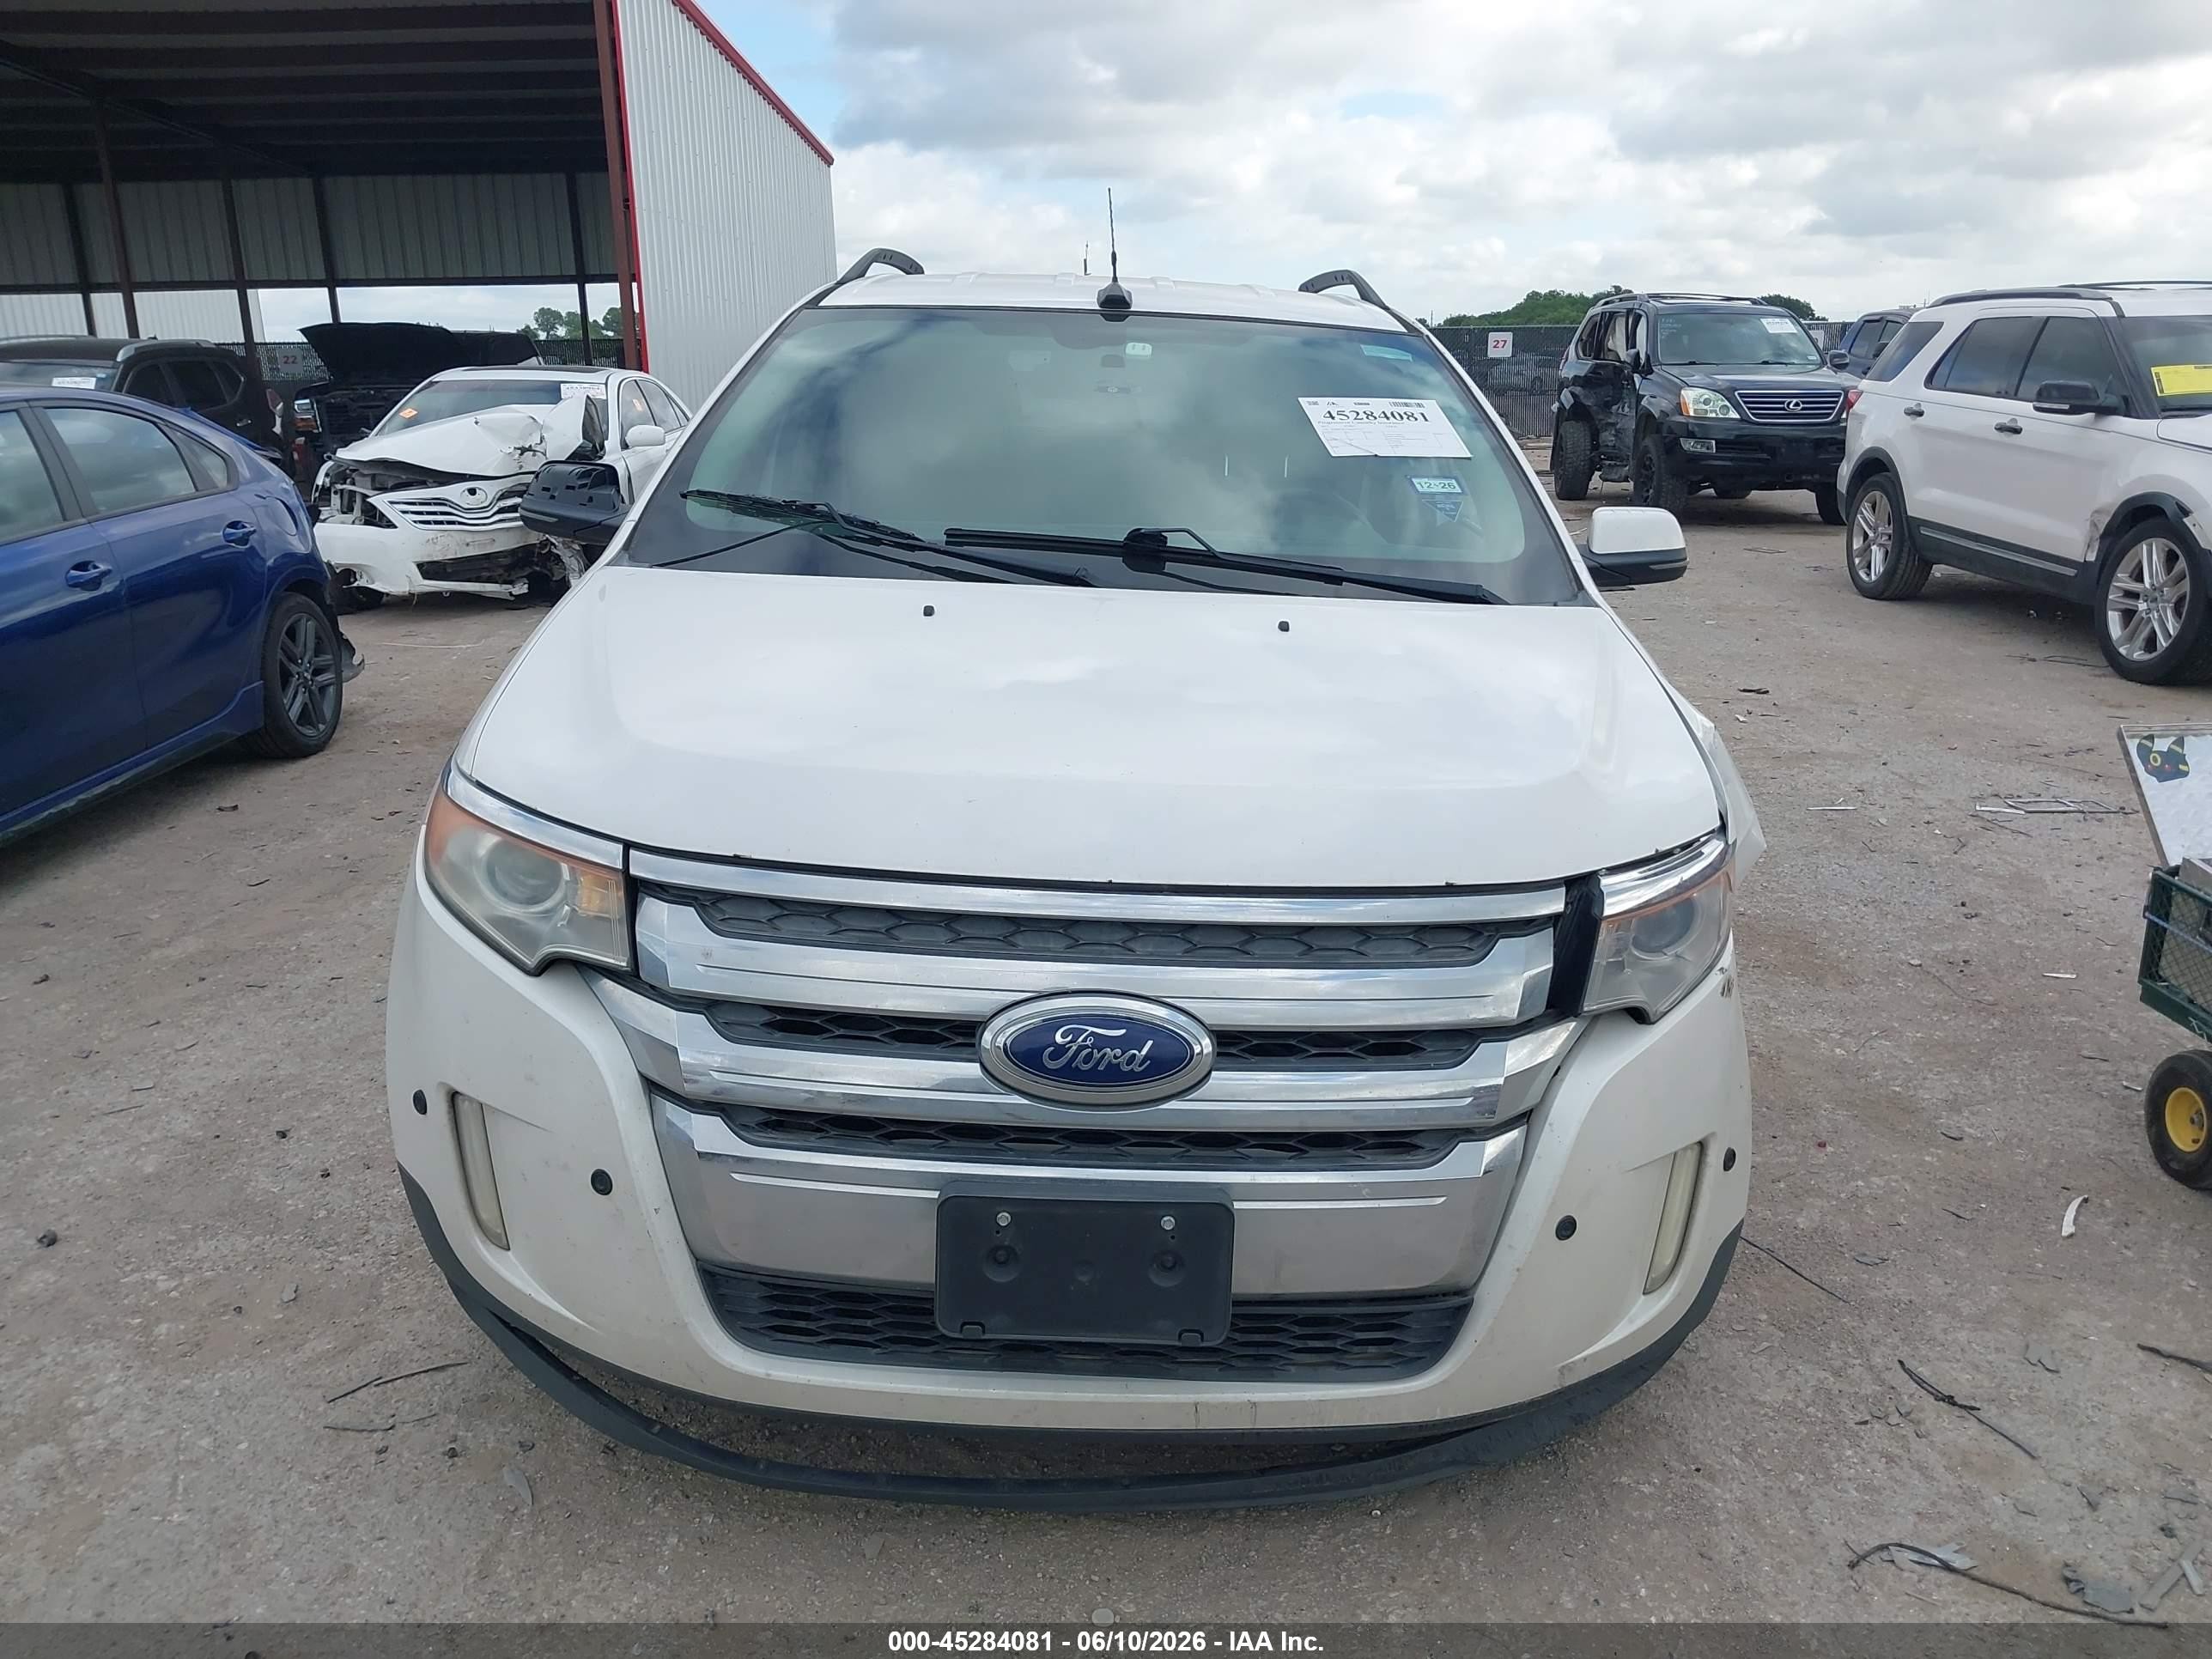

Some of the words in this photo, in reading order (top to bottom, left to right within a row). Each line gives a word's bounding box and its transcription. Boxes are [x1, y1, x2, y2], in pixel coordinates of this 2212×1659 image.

[1492, 339, 1508, 349] 27
[283, 356, 298, 365] 22
[1322, 410, 1430, 422] 45284081
[1042, 1024, 1154, 1073] Ford
